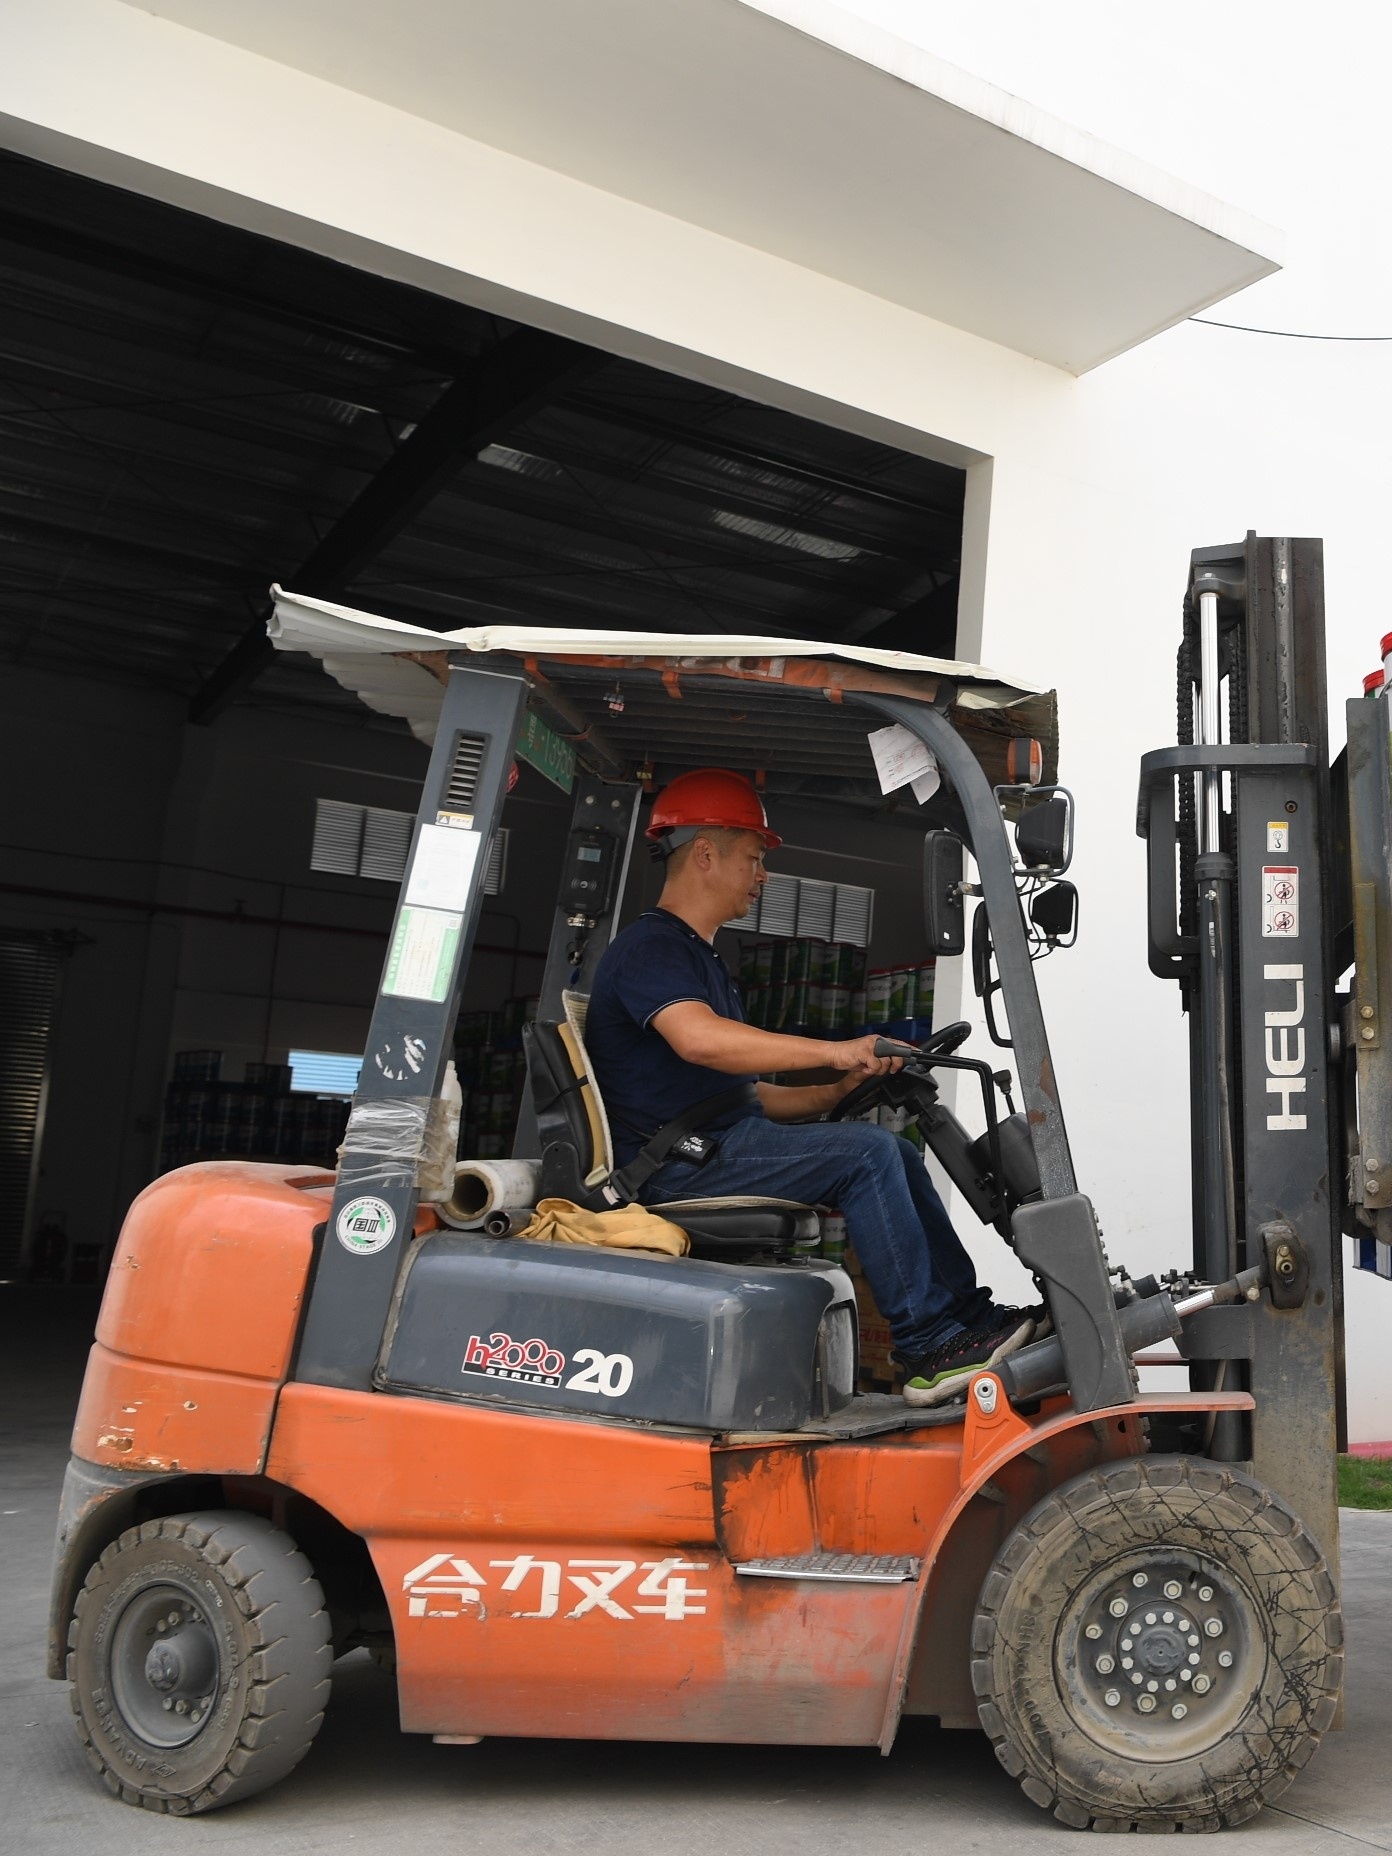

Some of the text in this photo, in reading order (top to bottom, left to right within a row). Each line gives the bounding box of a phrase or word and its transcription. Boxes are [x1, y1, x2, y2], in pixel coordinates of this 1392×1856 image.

[1263, 964, 1307, 1131] HELI
[485, 1367, 555, 1385] SERIES
[565, 1348, 634, 1398] 20
[402, 1553, 710, 1621] 合力叉车
